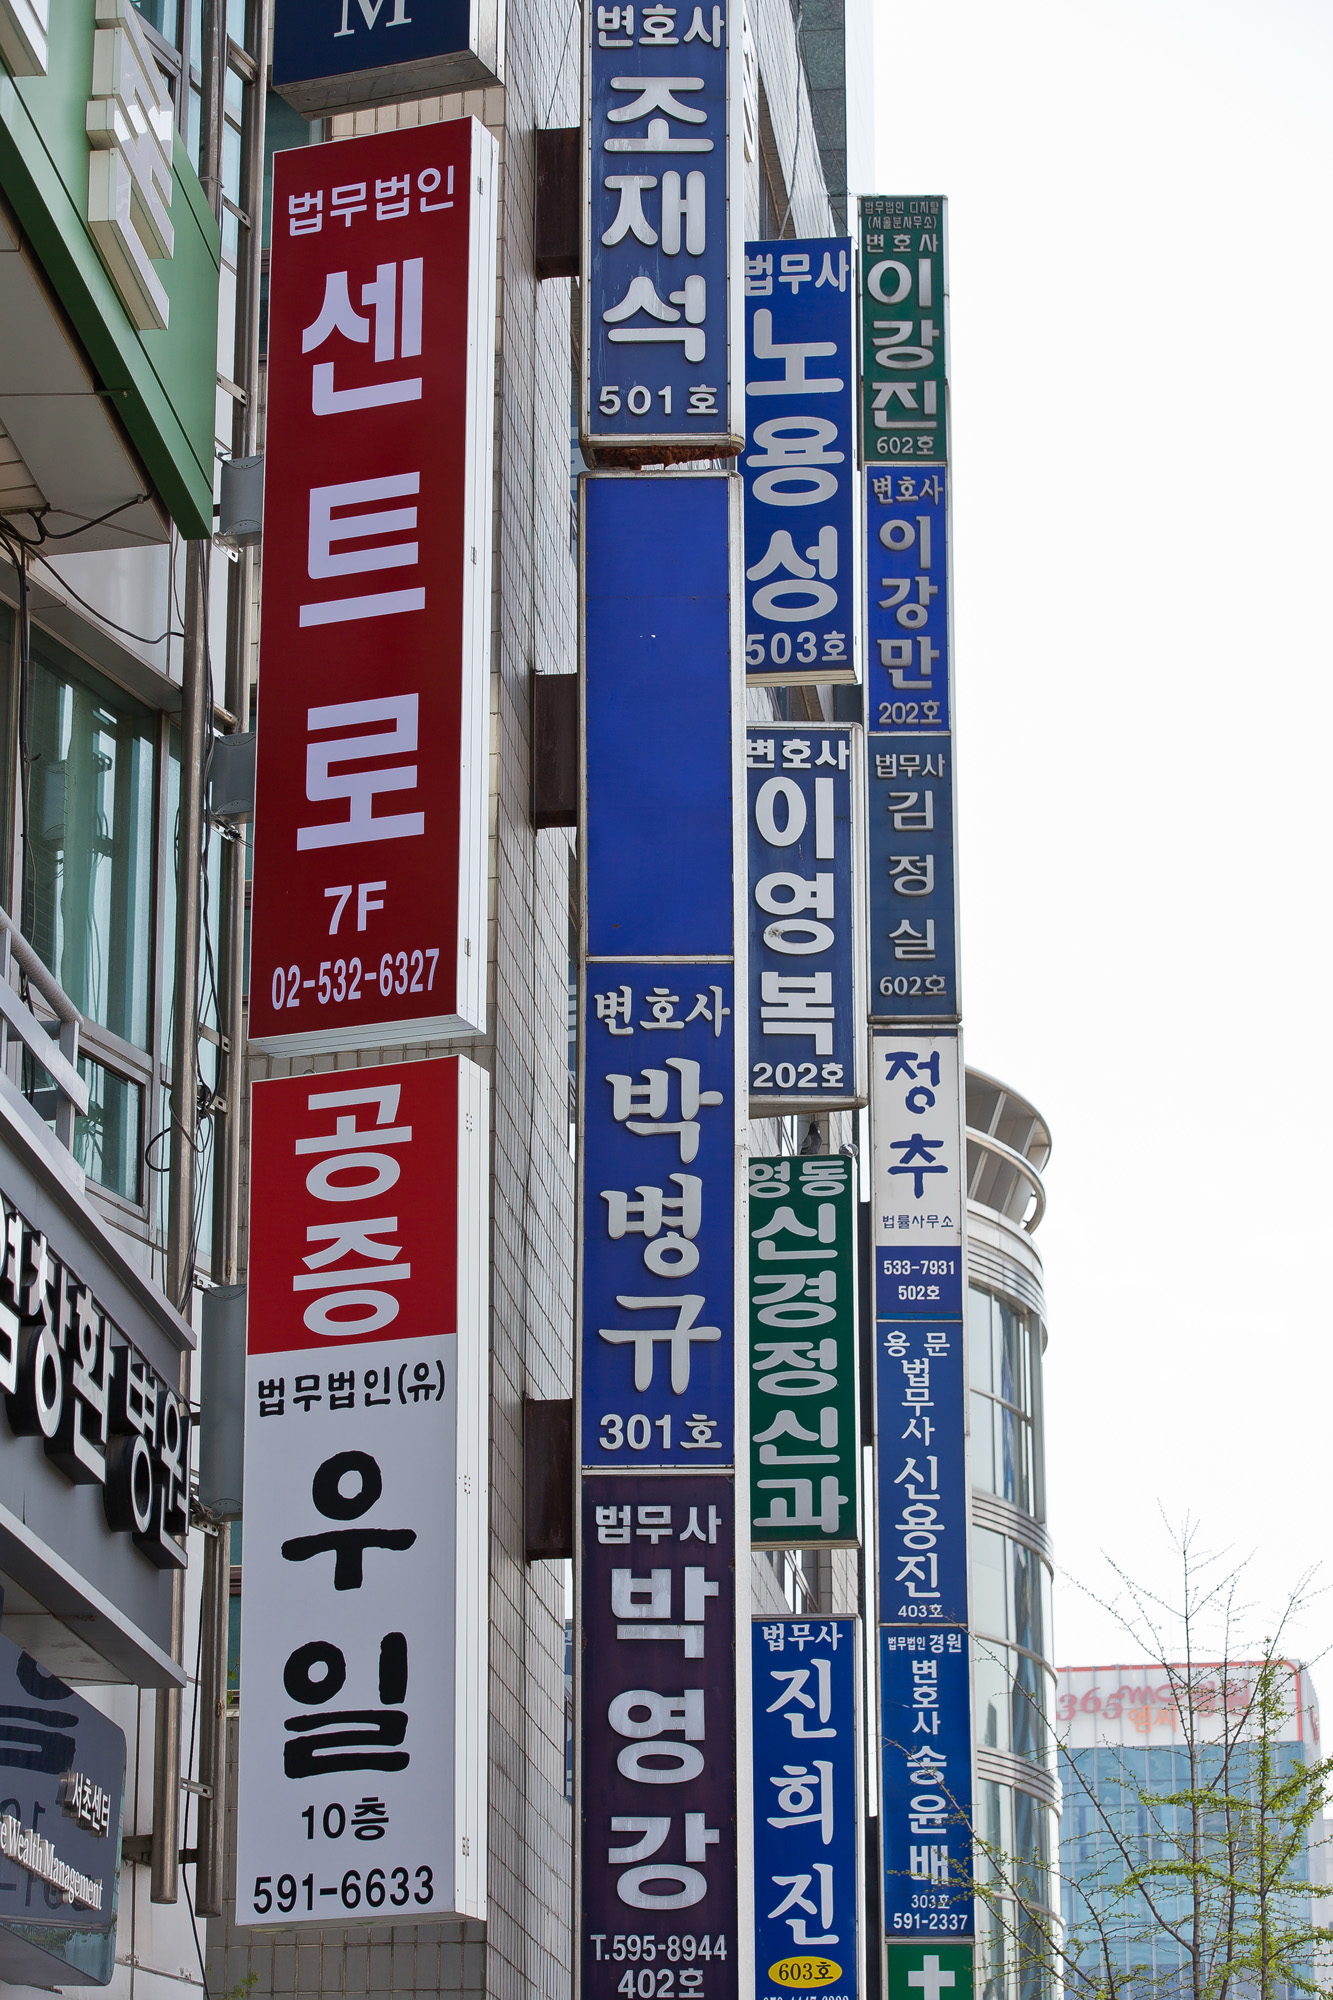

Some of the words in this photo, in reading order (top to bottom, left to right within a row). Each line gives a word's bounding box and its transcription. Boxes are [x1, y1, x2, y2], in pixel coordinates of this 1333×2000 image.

[597, 4, 725, 48] 변호사
[288, 165, 455, 236] 법무법인
[601, 77, 714, 363] 조재석
[865, 201, 904, 214] 법무법인
[866, 233, 938, 253] 변호사
[867, 216, 937, 230] (서울분사무소)
[745, 250, 849, 296] 법무사
[867, 258, 940, 429] 이강진
[599, 384, 718, 416] 501호
[746, 308, 845, 623] 노용성
[876, 435, 934, 455] 602호
[872, 475, 943, 505] 변호사
[297, 257, 425, 851] 센트로
[877, 516, 940, 689] 이강만
[745, 631, 847, 666] 503호
[878, 700, 942, 724] 202호
[746, 738, 850, 770] 변호사
[875, 754, 945, 779] 법무사
[888, 790, 936, 960] 김정실
[324, 880, 387, 935] 7F
[755, 776, 835, 1056] 이영복
[271, 948, 440, 1011] 02-532-6327
[879, 975, 946, 996] 602호
[594, 985, 731, 1037] 변호사
[752, 1062, 844, 1089] 202호
[885, 1050, 949, 1199] 정추
[749, 1160, 848, 1199] 영동
[293, 1083, 412, 1336] 공증
[599, 1057, 723, 1396] 박병규
[882, 1214, 954, 1230] 법률사무소
[883, 1260, 955, 1275] 533-7931
[898, 1285, 940, 1300] 502호
[257, 1359, 445, 1418] 법무법인(유)
[751, 1202, 849, 1533] 신경정신과
[901, 1357, 935, 1447] 법무사
[599, 1414, 722, 1451] 301호
[595, 1505, 722, 1545] 법무사
[894, 1455, 945, 1598] 신용진
[281, 1450, 417, 1779] 우일
[898, 1604, 943, 1618] 403호
[762, 1622, 843, 1652] 법무사
[887, 1636, 926, 1651] 법무법인
[929, 1633, 962, 1654] 경원
[912, 1660, 941, 1735] 변호사
[608, 1566, 720, 1910] 박영강
[72, 1772, 111, 1838] 서초센터
[301, 1797, 389, 1841] 10층
[766, 1658, 839, 1945] 진희진
[9, 1815, 43, 1873] Wealth
[43, 1839, 104, 1911] Management
[253, 1865, 434, 1915] 591-6633
[911, 1894, 950, 1909] 303호
[893, 1912, 968, 1930] 591-2337
[590, 1935, 728, 1961] T.595-8944
[618, 1968, 705, 1999] 402호
[778, 1961, 834, 1981] 603호
